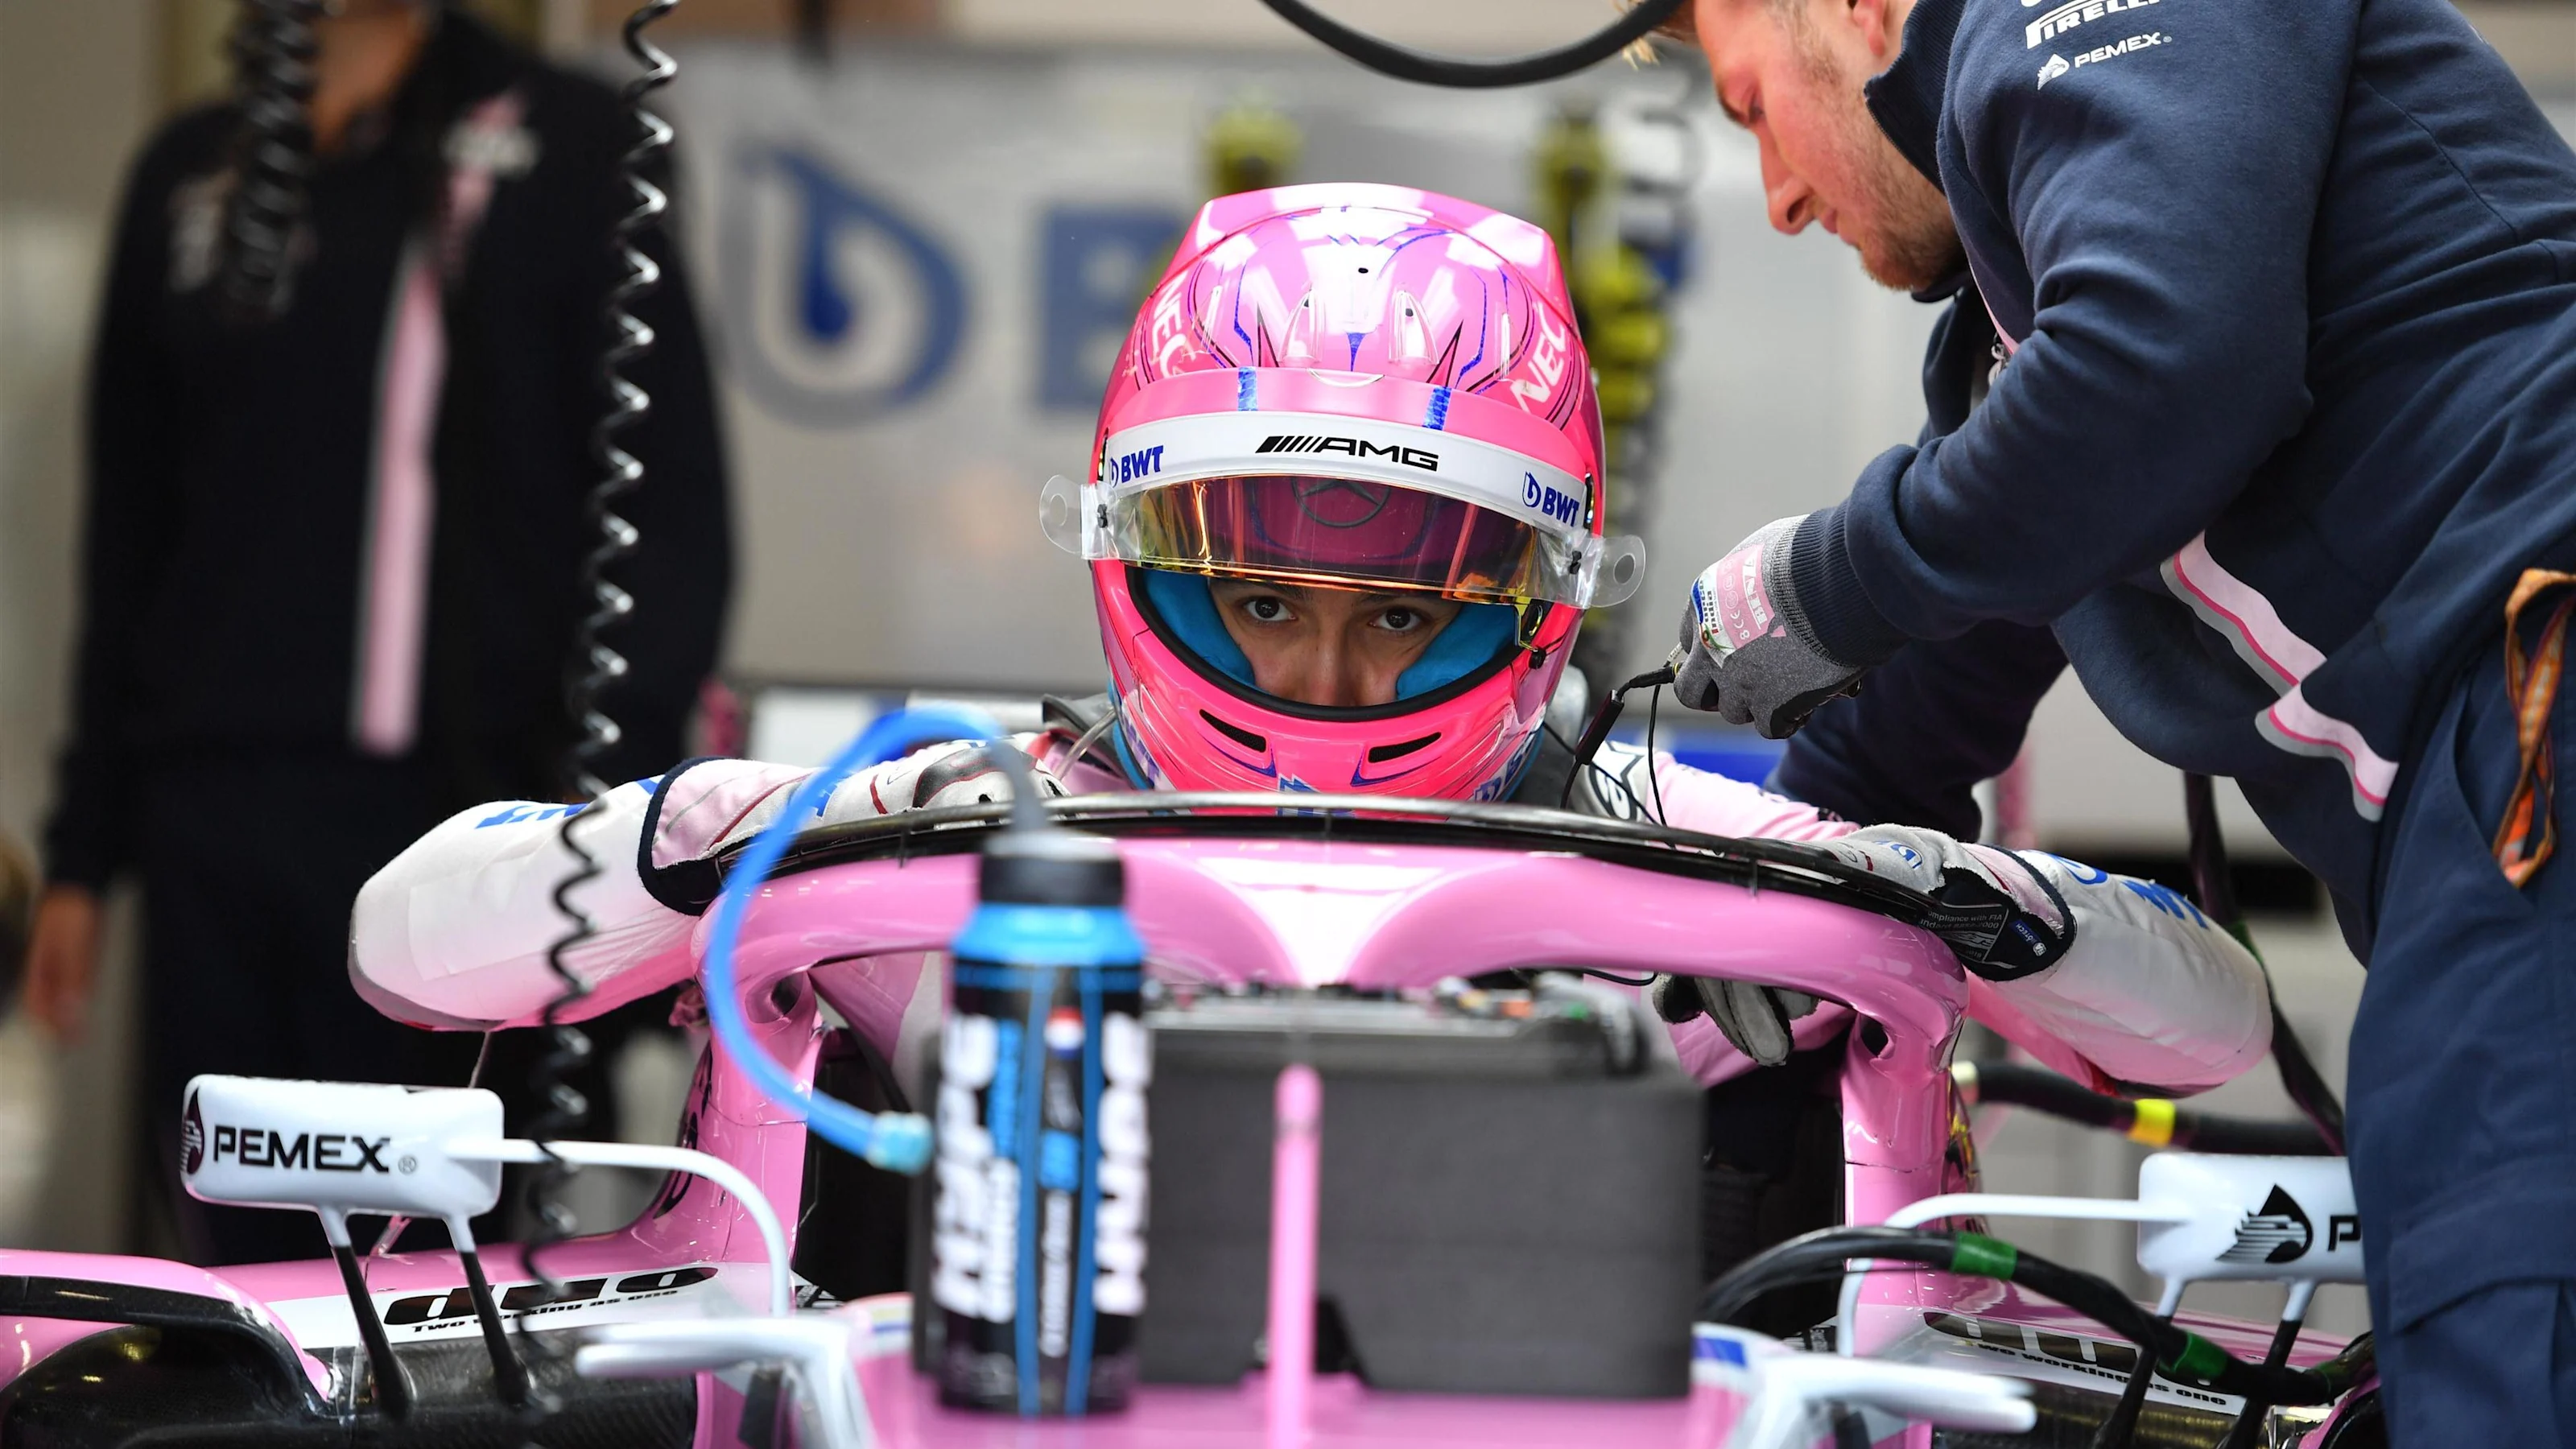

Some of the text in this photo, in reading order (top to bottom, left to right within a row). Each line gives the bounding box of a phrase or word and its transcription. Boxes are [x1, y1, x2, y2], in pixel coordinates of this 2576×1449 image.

[2025, 0, 2160, 49] PIRELL
[2074, 32, 2161, 68] PEMEX
[1151, 270, 1196, 378] NEC
[1510, 301, 1566, 414] NEC
[1121, 445, 1163, 483] BWT
[1313, 437, 1439, 472] AMG
[1542, 486, 1579, 527] BWT
[1928, 911, 1970, 923] ompliance
[213, 1125, 390, 1173] PEMEX
[412, 1320, 465, 1333] Two
[2176, 1389, 2227, 1406] one
